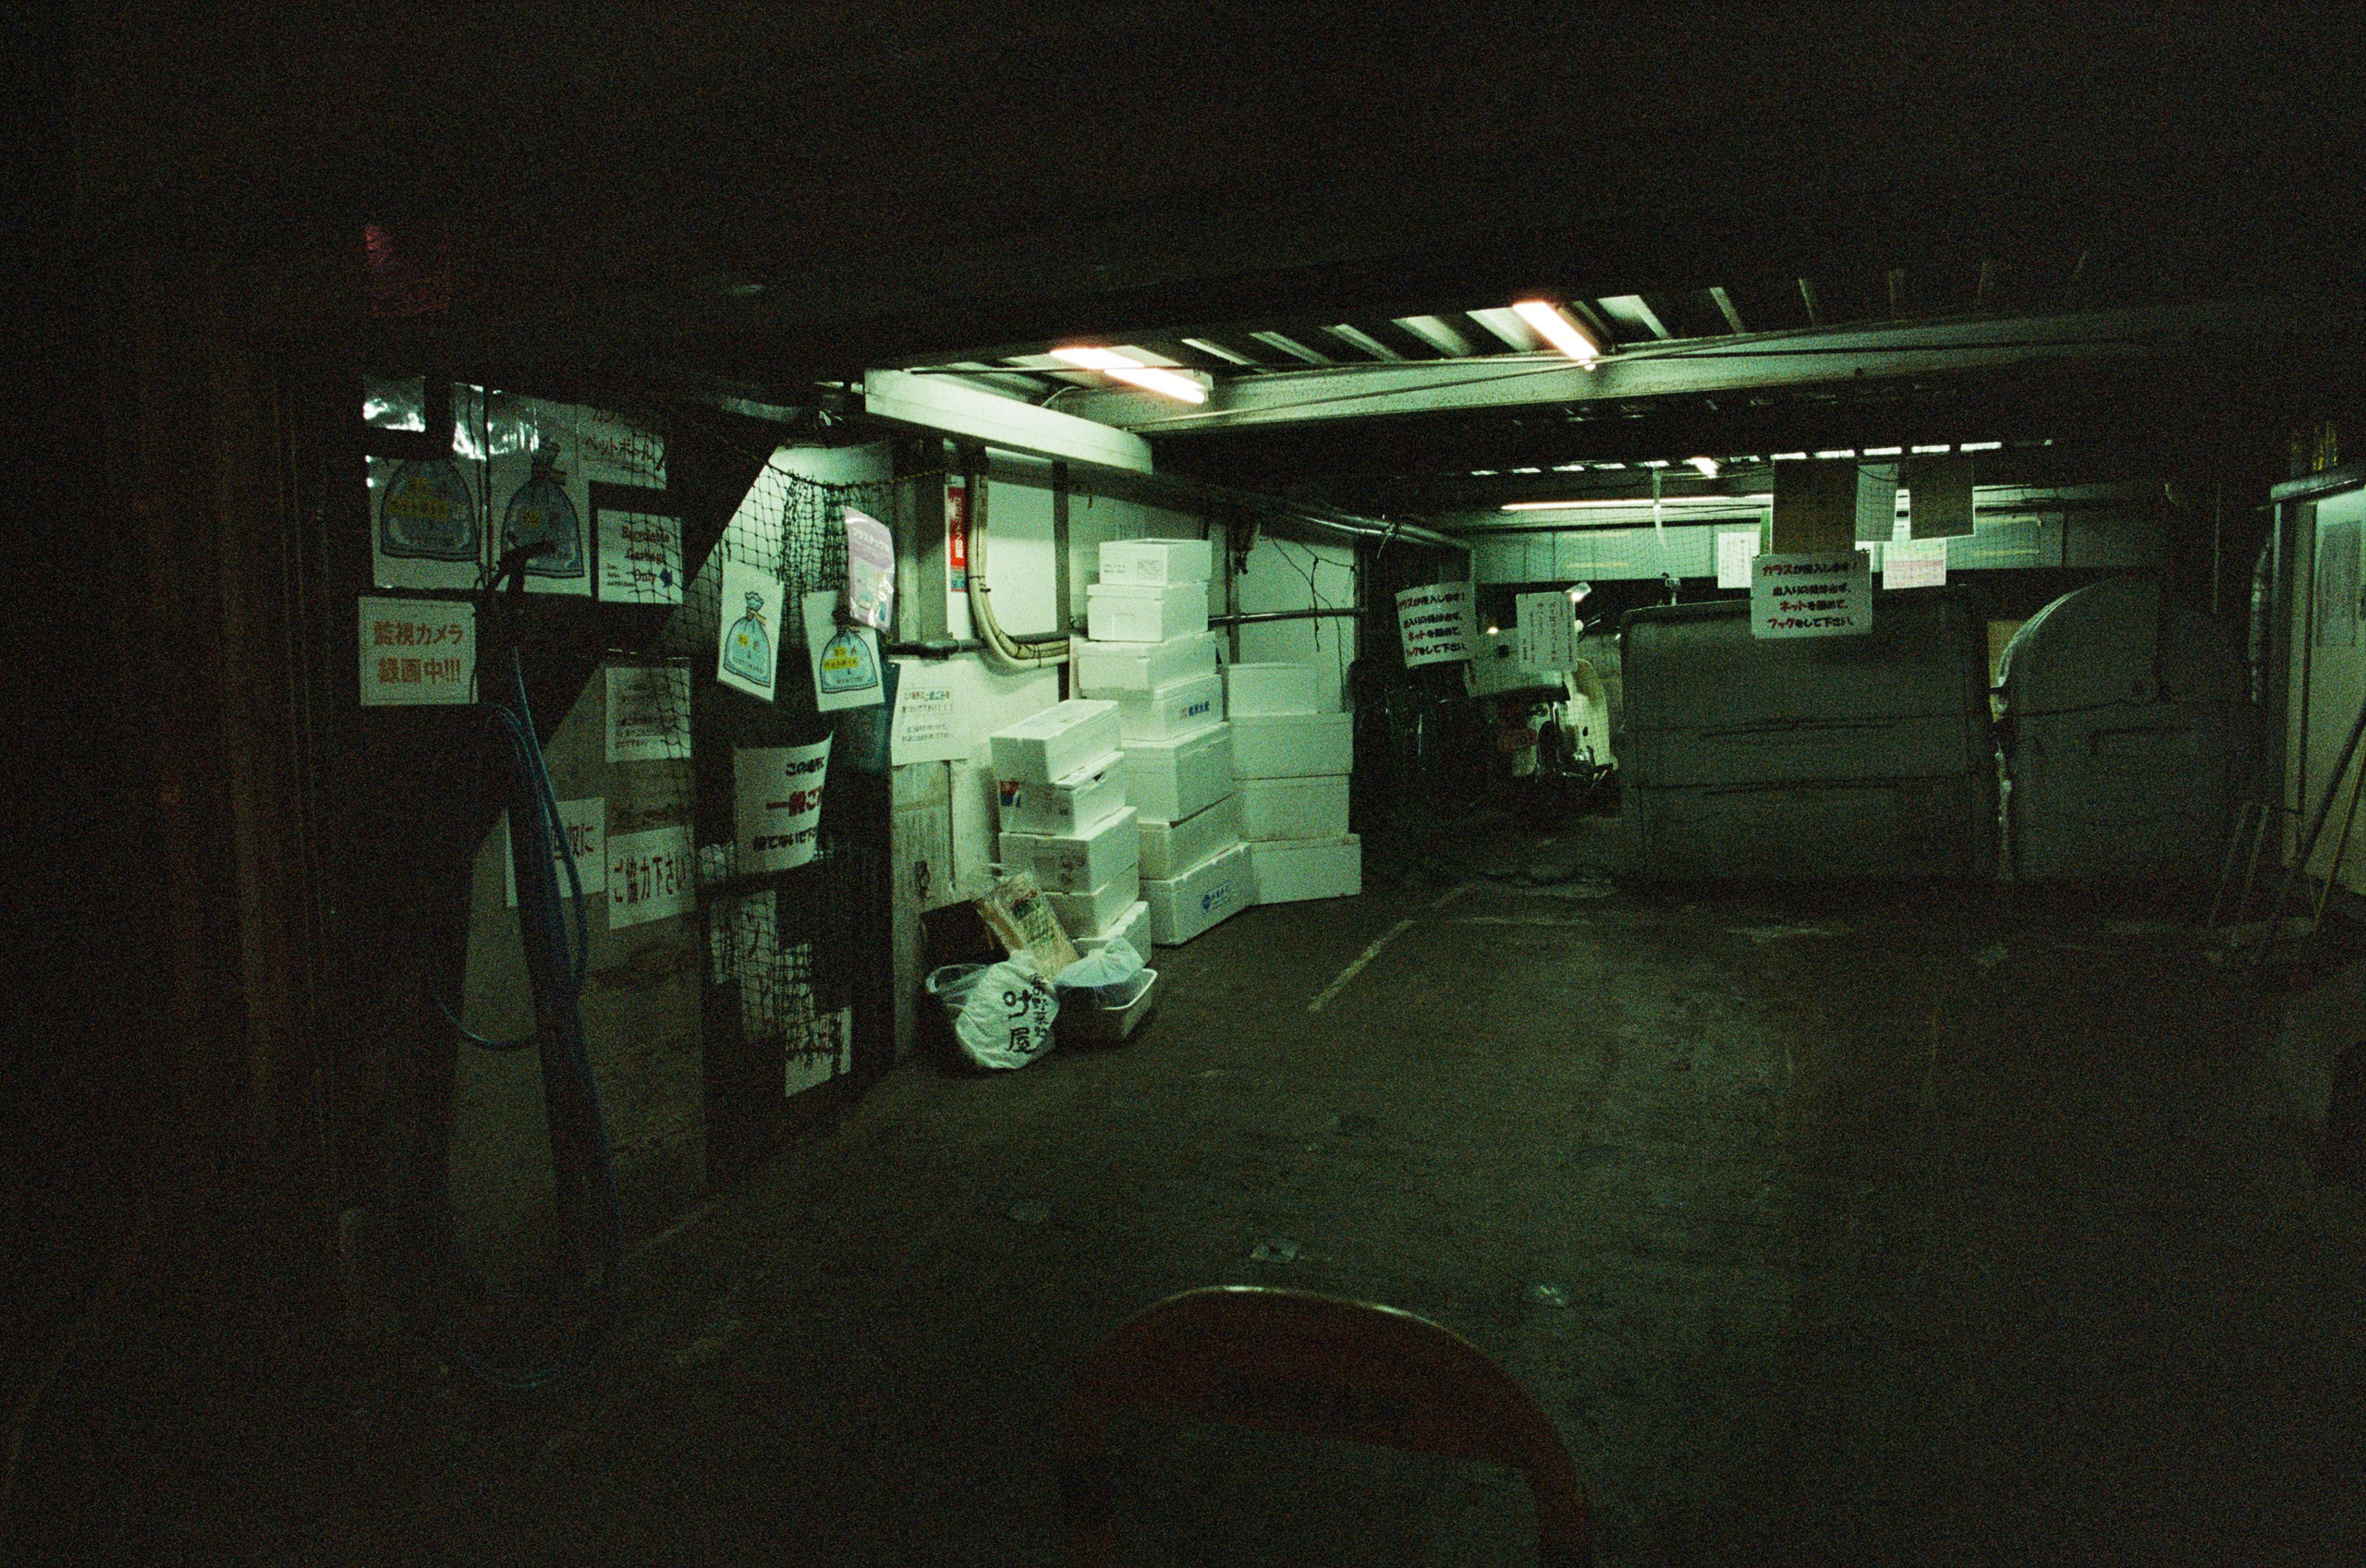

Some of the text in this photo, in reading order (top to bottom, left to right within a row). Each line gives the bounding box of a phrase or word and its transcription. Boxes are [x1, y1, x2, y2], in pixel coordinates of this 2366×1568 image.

[373, 620, 463, 646] 監視カメラ
[378, 657, 461, 684] 録画中!!!
